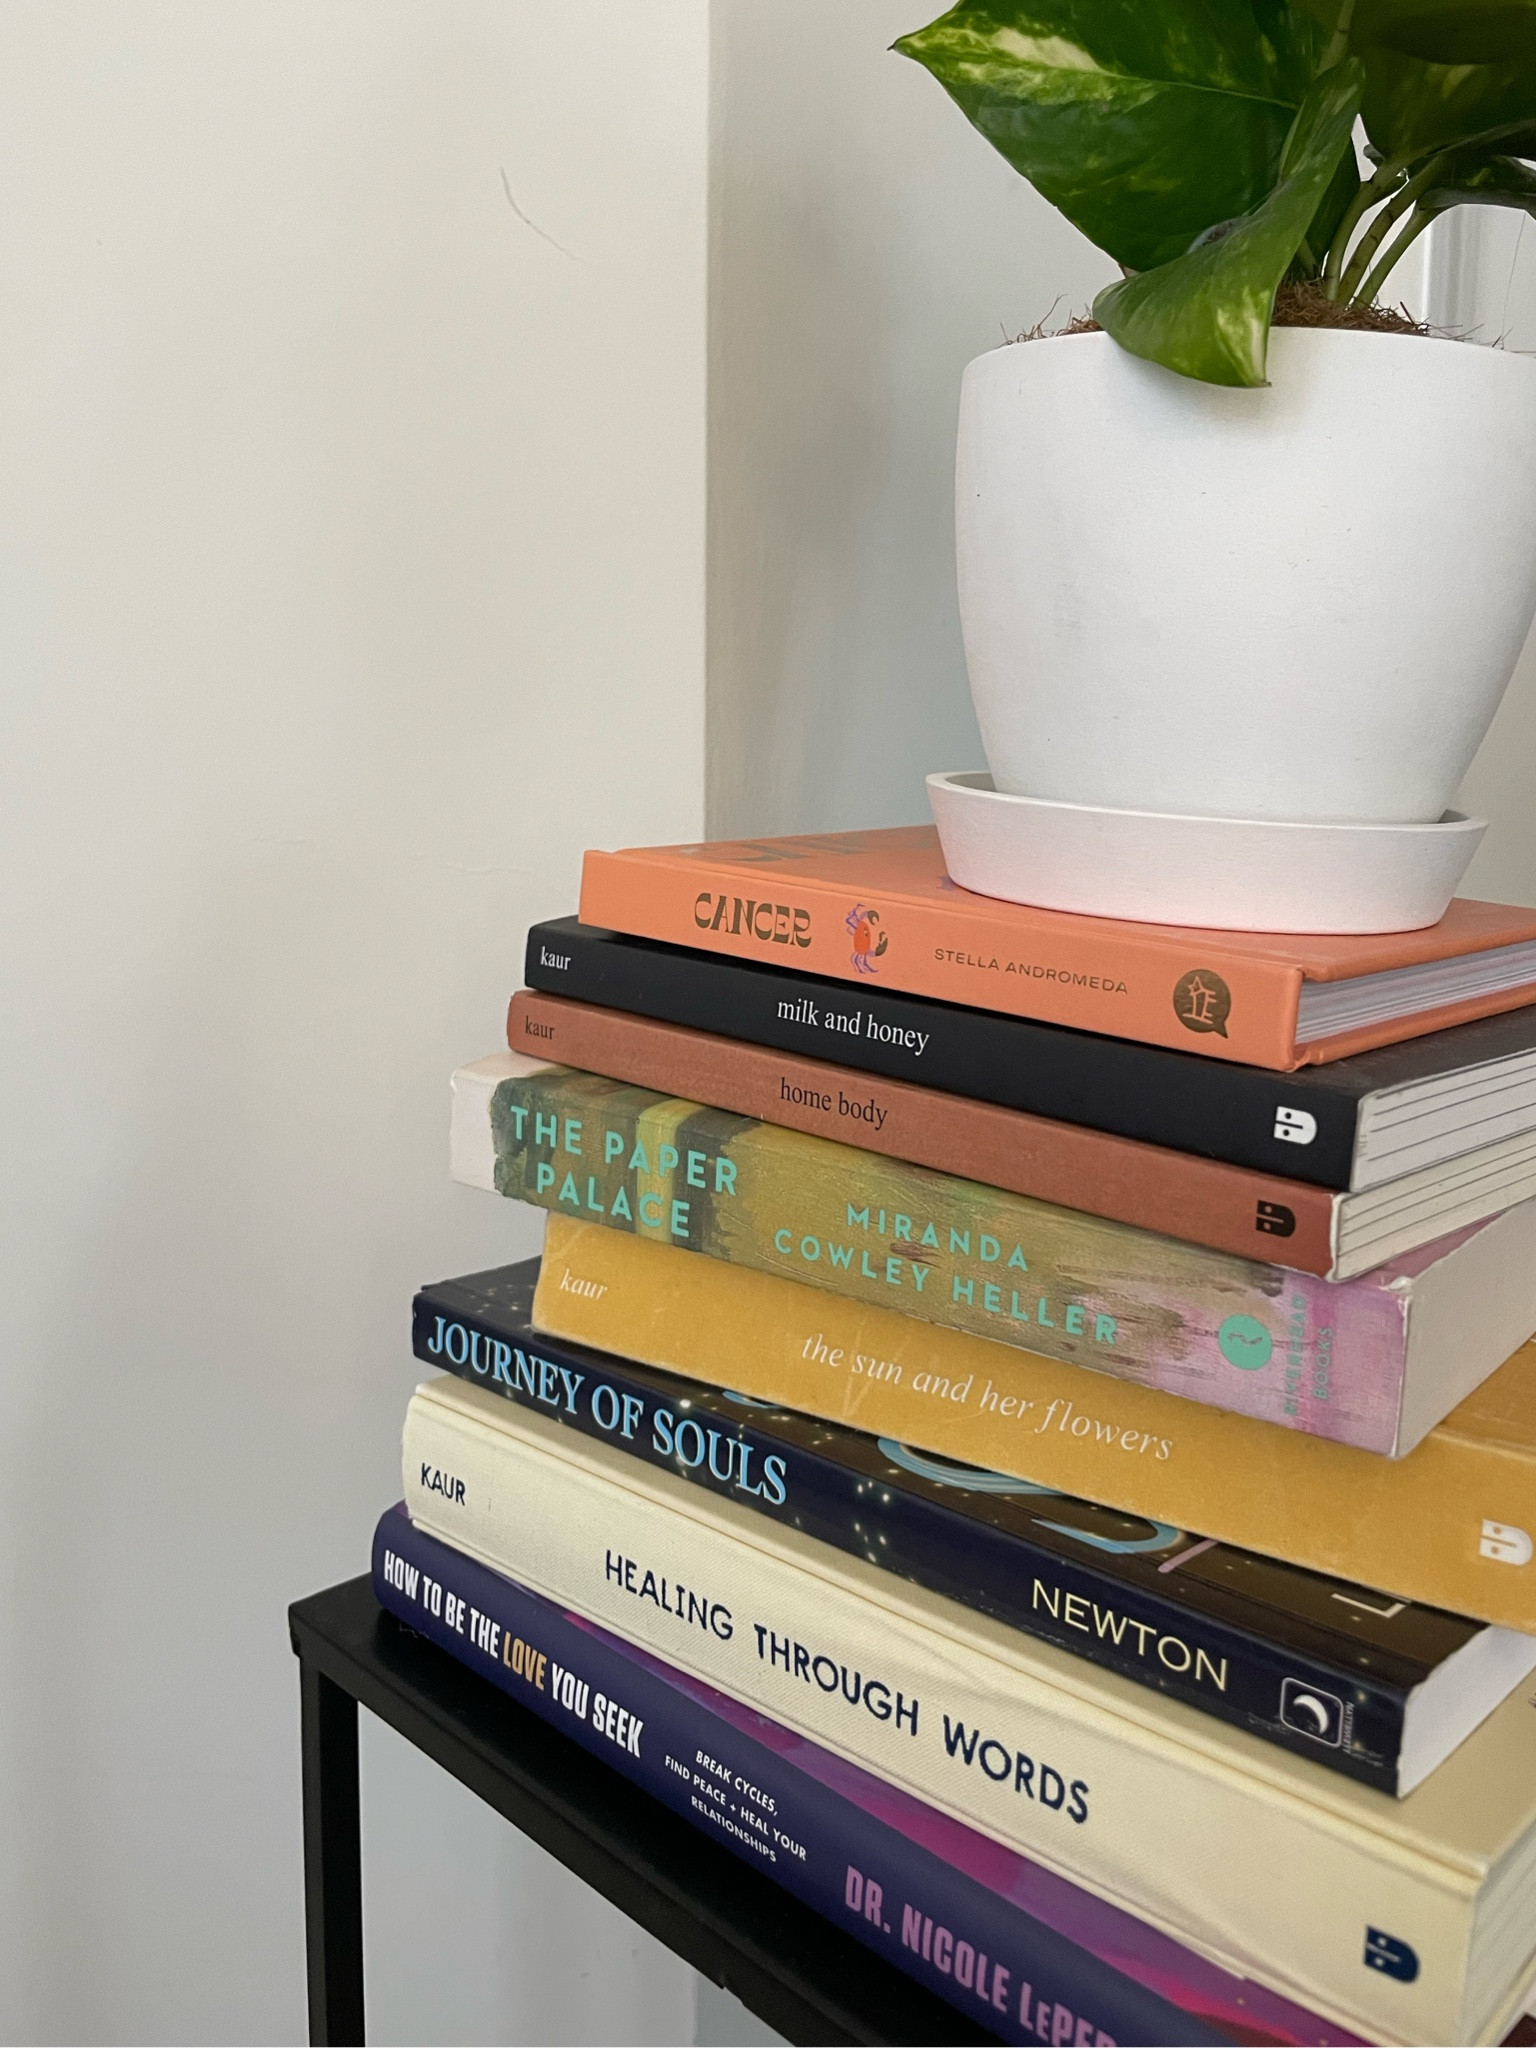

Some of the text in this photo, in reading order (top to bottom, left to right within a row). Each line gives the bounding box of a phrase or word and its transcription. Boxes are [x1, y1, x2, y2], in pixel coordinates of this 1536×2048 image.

[694, 892, 812, 948] CANCER
[540, 946, 572, 971] kaur
[934, 948, 1128, 995] STELLA ANDROMEDA
[525, 1015, 555, 1041] kaur
[777, 1000, 930, 1056] milk and honey
[780, 1077, 888, 1131] home body
[510, 1105, 738, 1196] THE PAPER
[536, 1162, 690, 1237] PALACE
[847, 1203, 1029, 1272] MIRANDA
[559, 1268, 608, 1300] kaur
[774, 1228, 1116, 1345] COWLEY HELLER
[802, 1333, 1173, 1461] the sun and her flowers
[1312, 1326, 1333, 1400] BOOKS
[427, 1315, 788, 1505] JOURNEY OF SOULS
[420, 1462, 467, 1506] KAUR
[384, 1549, 644, 1759] HOW TO BE THE LOVE YOU SEEK
[1032, 1578, 1228, 1692] NEWTON
[605, 1550, 1090, 1825] HEALING THROUGH WORDS
[664, 1754, 807, 1862] FIND PEACE + HEAL YOUR
[695, 1750, 779, 1818] BREAK CYCLES,
[691, 1794, 777, 1862] RELATIONSHIPS
[845, 1865, 891, 1935] DR.
[901, 1903, 1010, 2013] NICOLE
